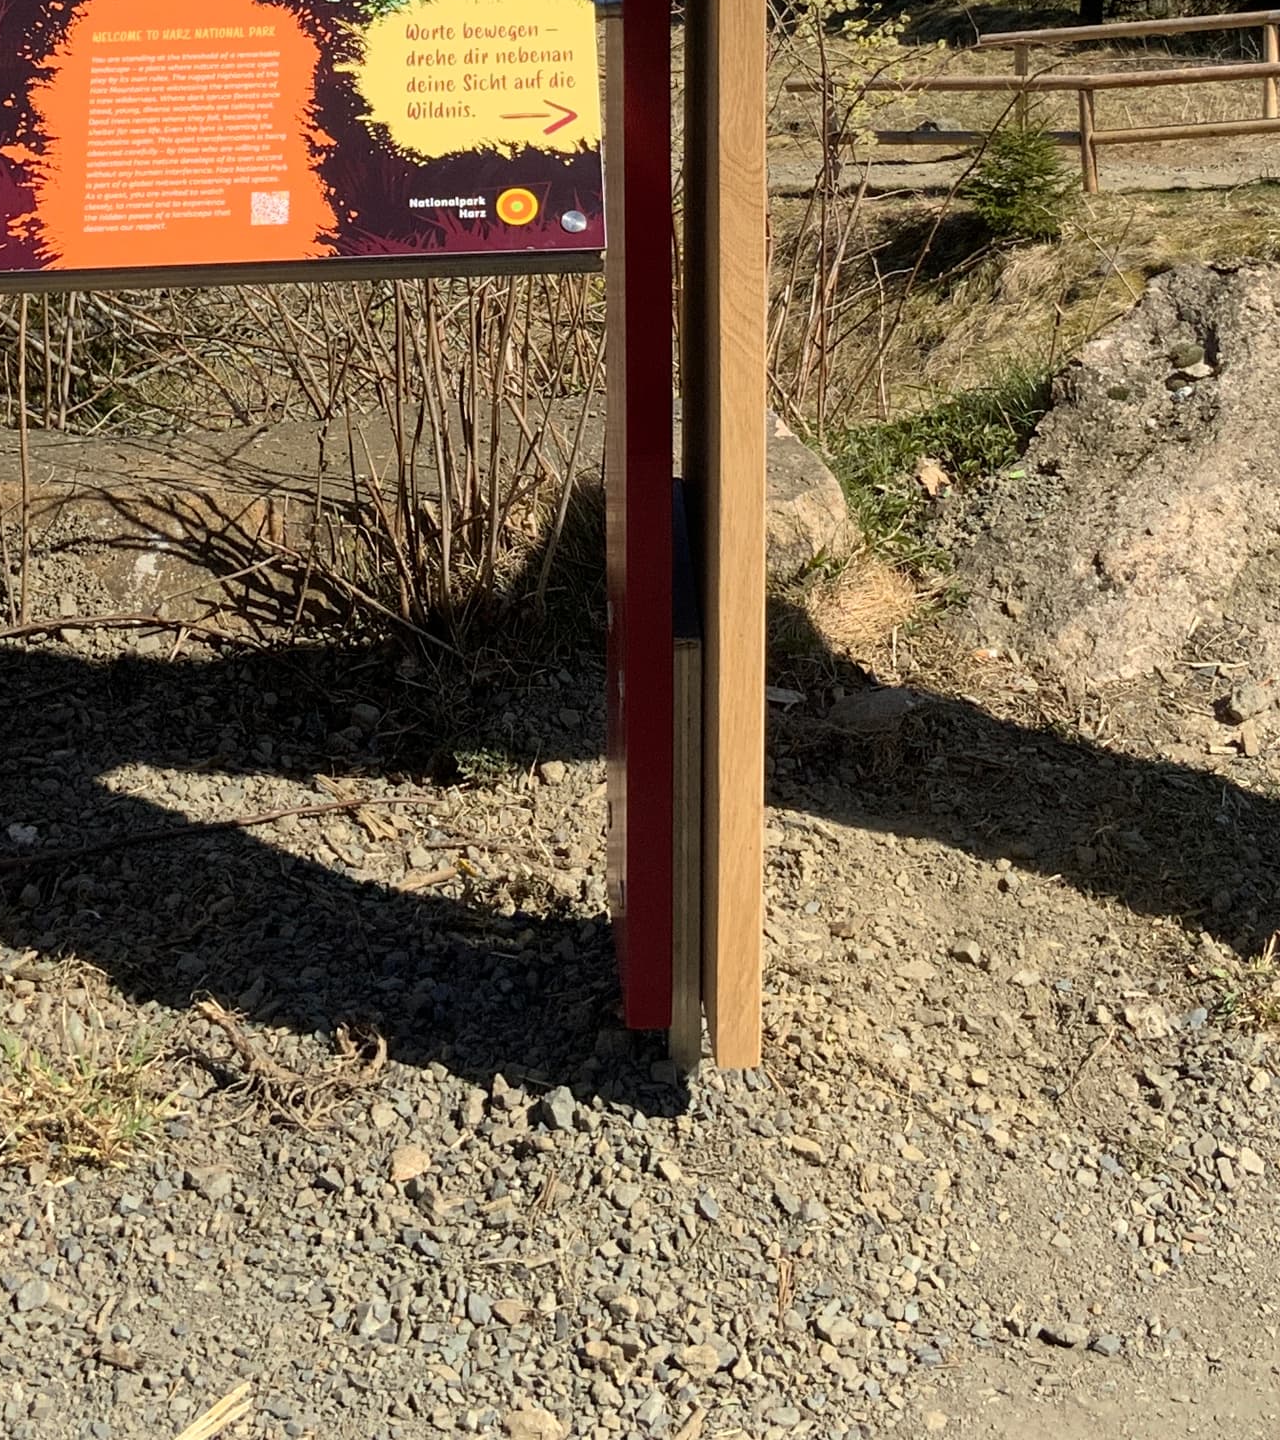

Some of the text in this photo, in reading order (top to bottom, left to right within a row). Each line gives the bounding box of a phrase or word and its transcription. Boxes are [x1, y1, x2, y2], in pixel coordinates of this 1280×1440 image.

[92, 25, 276, 43] WELCOME TO HARZ NATIONAL PARK
[405, 23, 456, 41] Worte
[462, 22, 539, 41] bewegen
[406, 46, 574, 67] drehe dir nebenan
[406, 69, 577, 94] deine Sicht auf die
[406, 101, 476, 121] Wildnis.
[408, 196, 486, 209] Nationalpark
[458, 209, 486, 219] Harz
